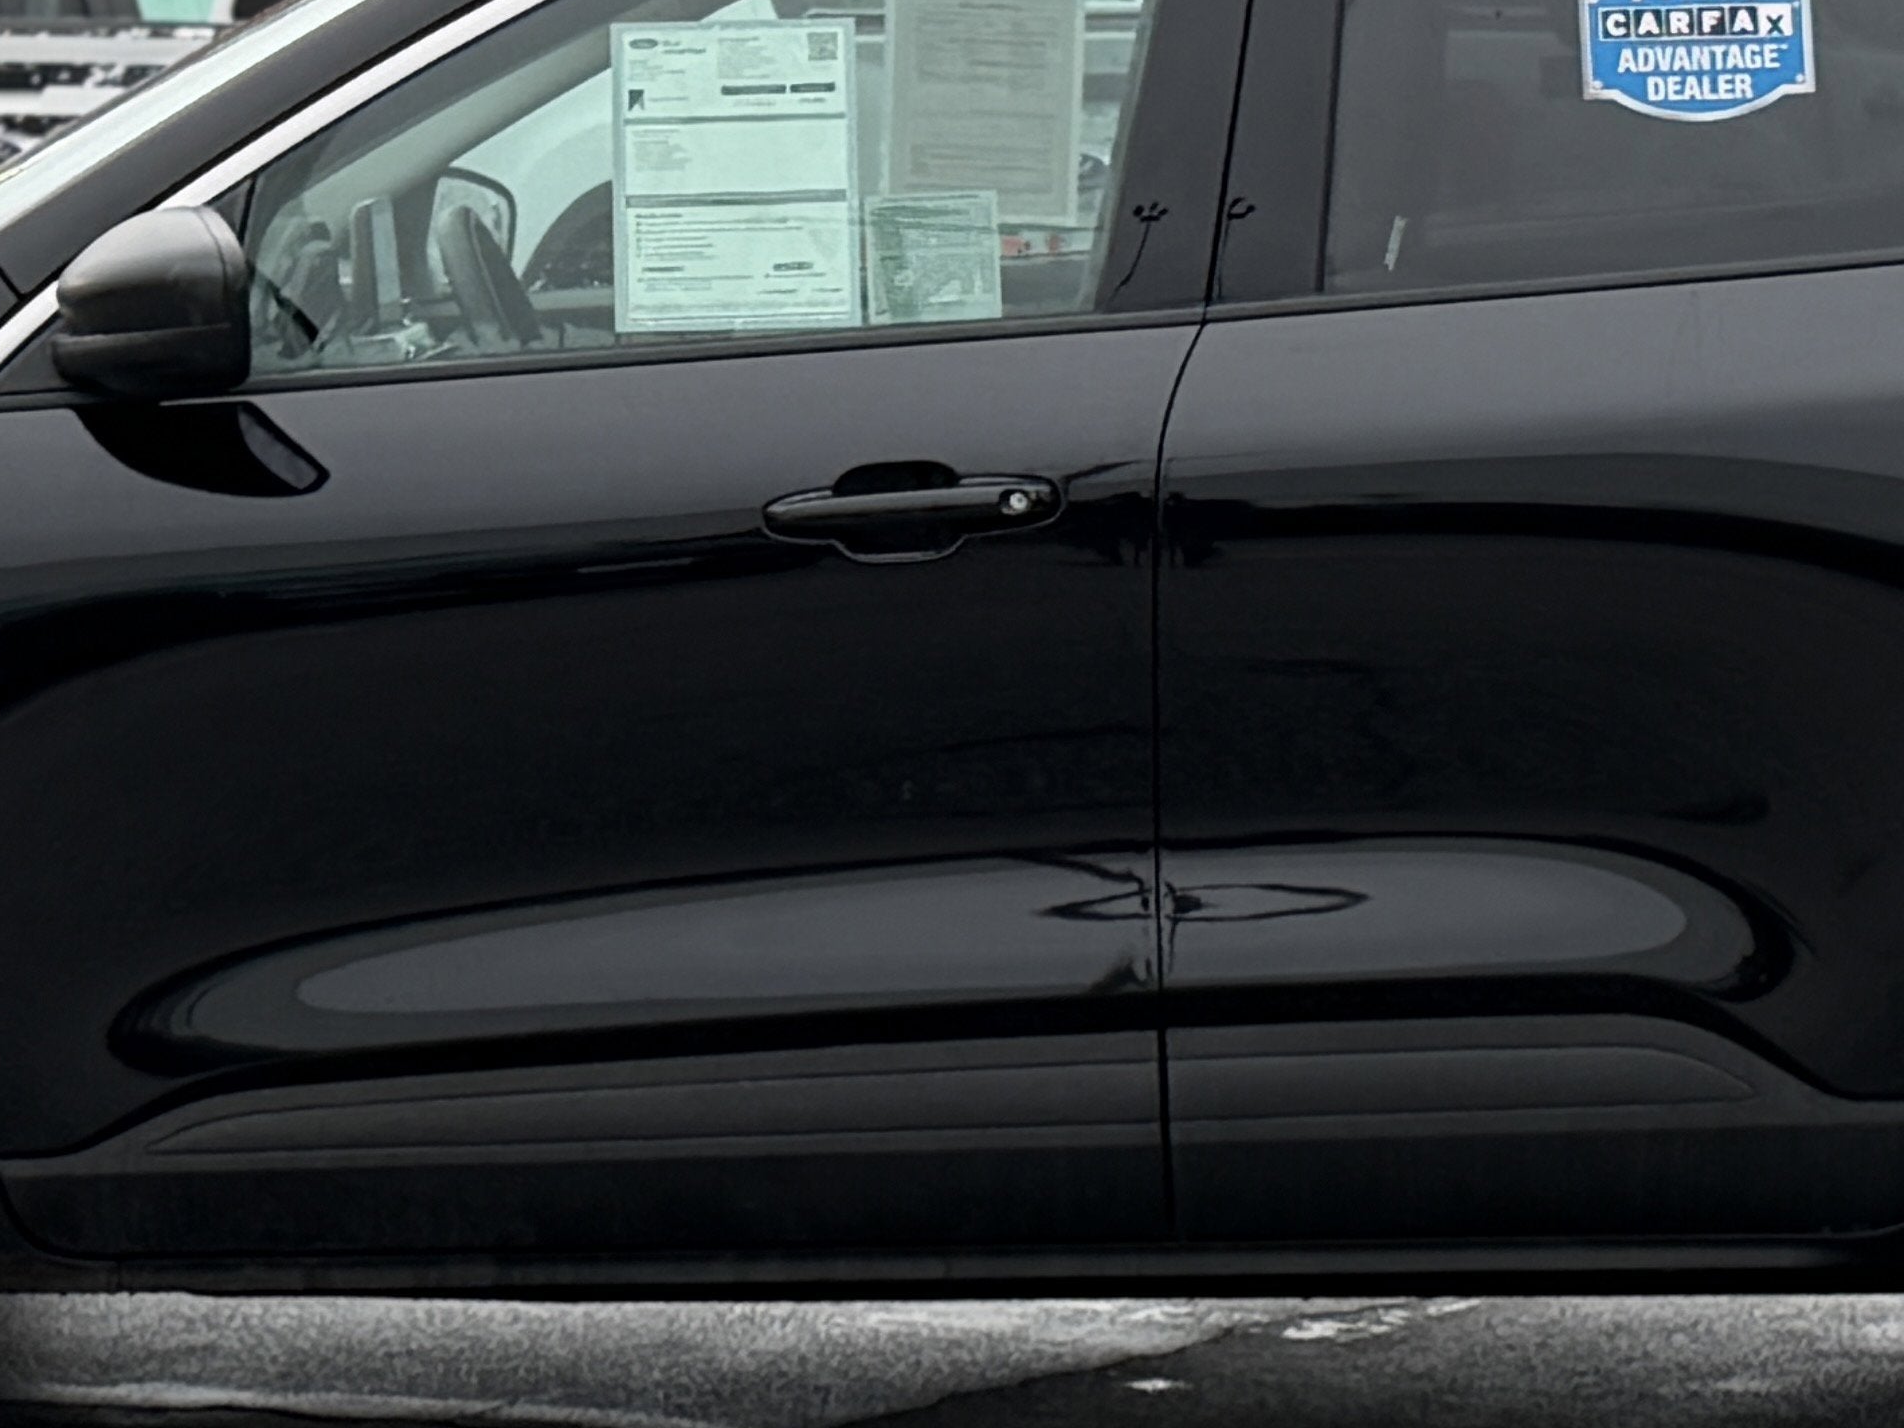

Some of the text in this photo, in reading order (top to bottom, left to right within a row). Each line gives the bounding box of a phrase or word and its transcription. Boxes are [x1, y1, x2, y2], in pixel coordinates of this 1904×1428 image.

[1603, 6, 1790, 38] CARFAX
[1617, 43, 1781, 73] ADVANTAGE
[1647, 74, 1752, 101] DEALER
